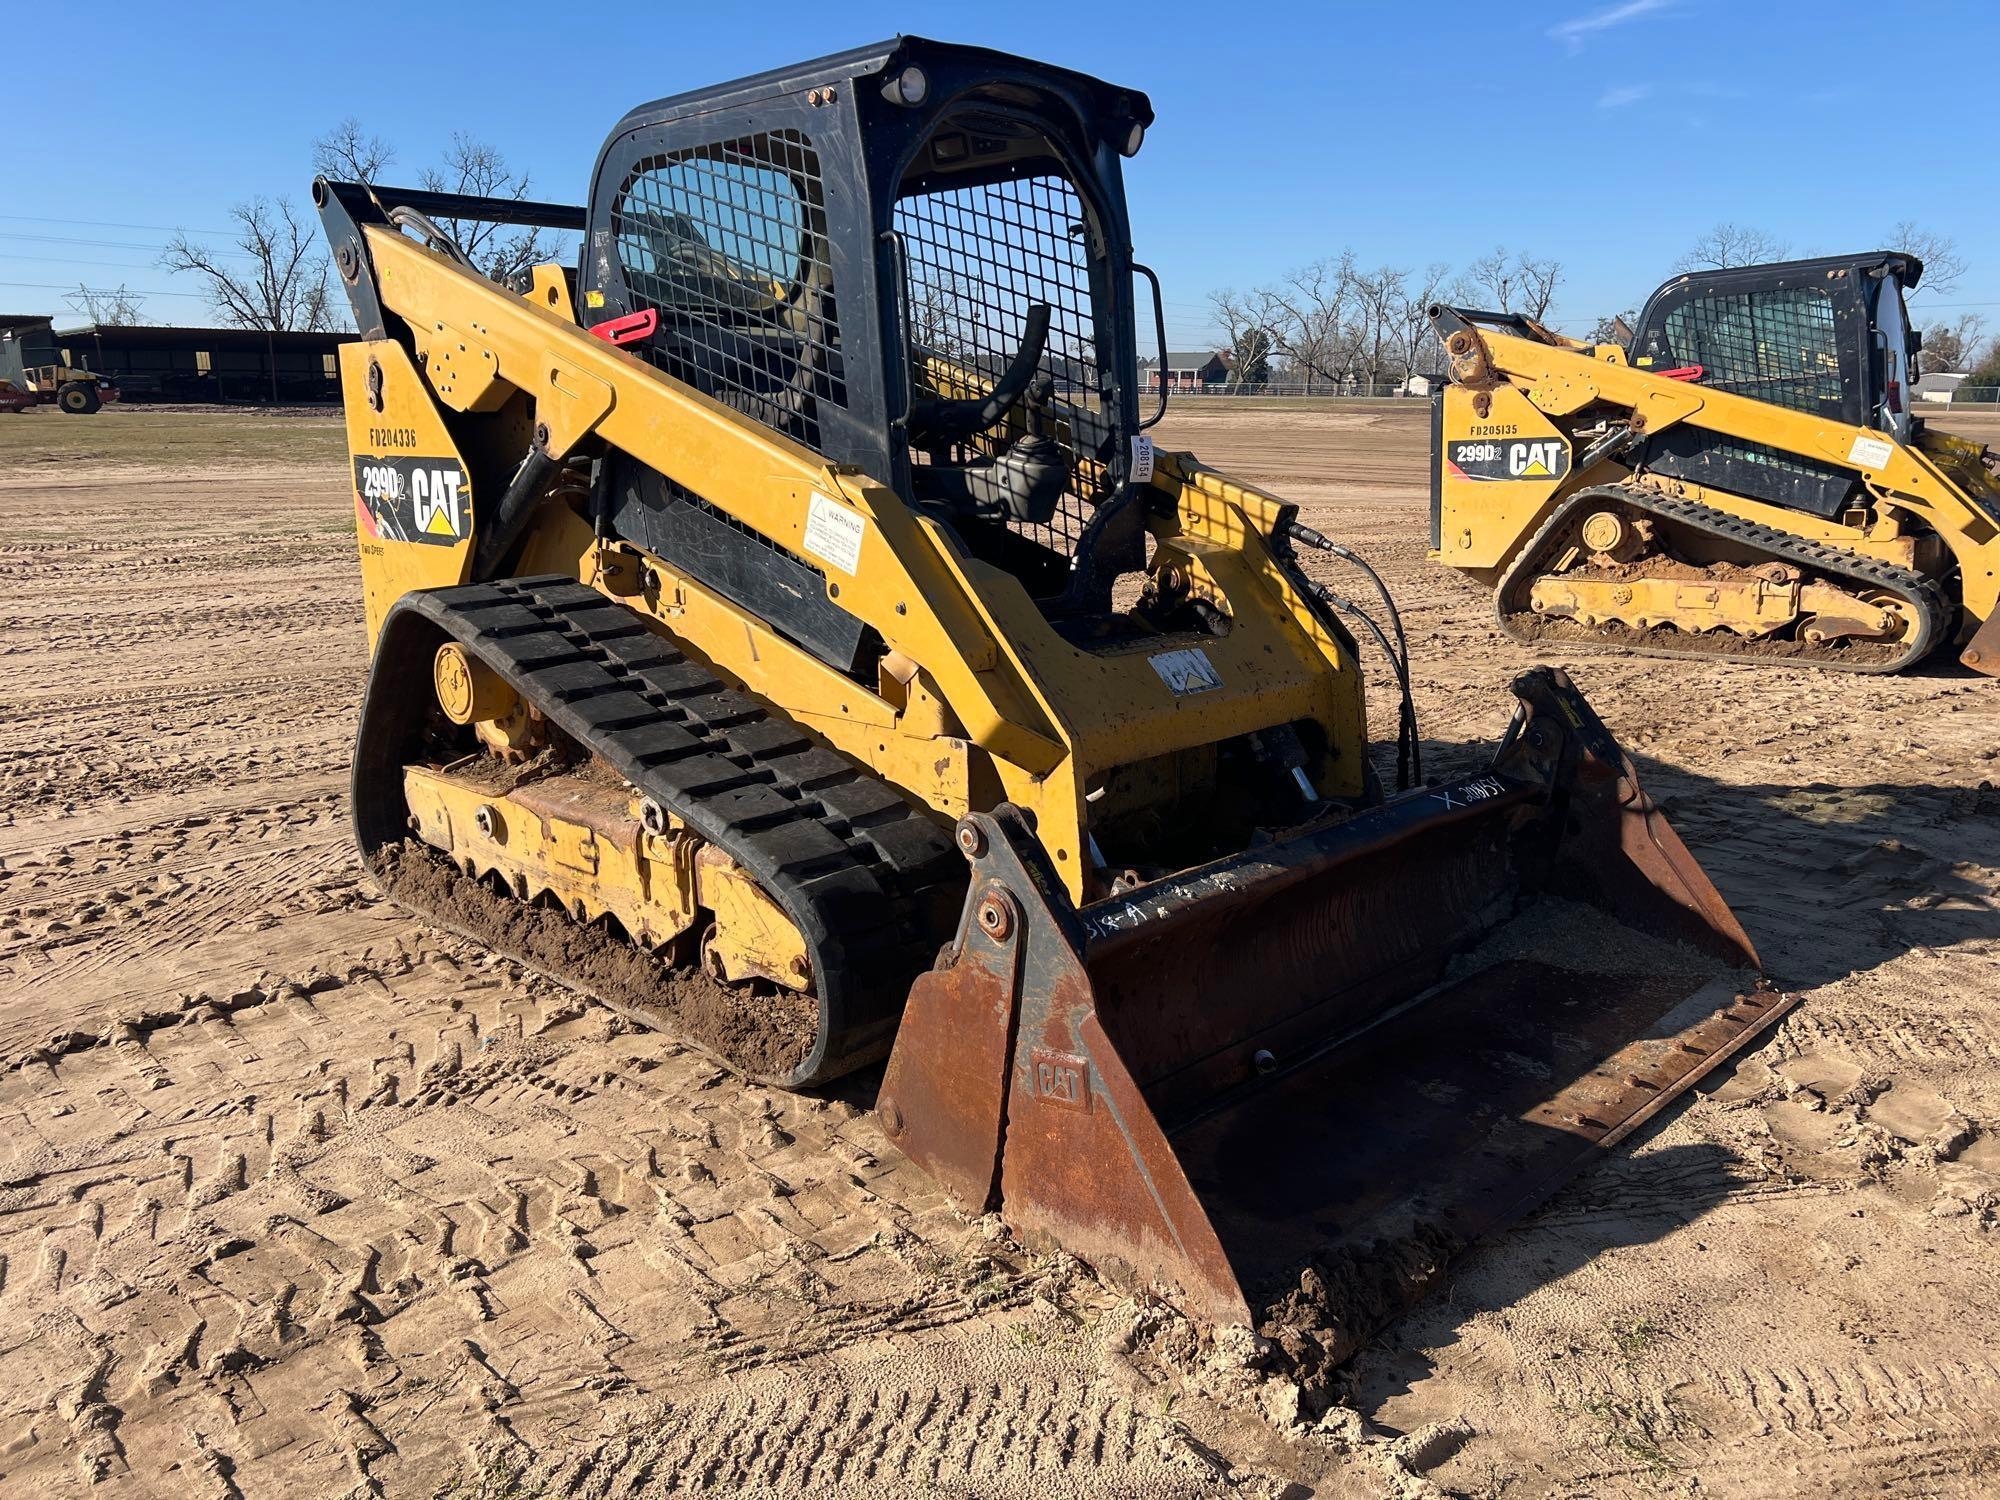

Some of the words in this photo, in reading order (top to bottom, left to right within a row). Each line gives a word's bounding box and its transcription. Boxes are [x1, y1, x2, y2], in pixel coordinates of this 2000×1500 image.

[369, 428, 417, 448] FD204336
[1470, 425, 1517, 436] FD205135
[1138, 445, 1150, 477] 208154
[1457, 444, 1502, 462] 299D2
[1509, 442, 1561, 475] CAT
[362, 466, 405, 499] 299D2
[411, 468, 461, 537] CAT
[828, 509, 861, 534] WARNING
[1458, 776, 1506, 802] 208154
[1037, 1062, 1079, 1102] CAT
